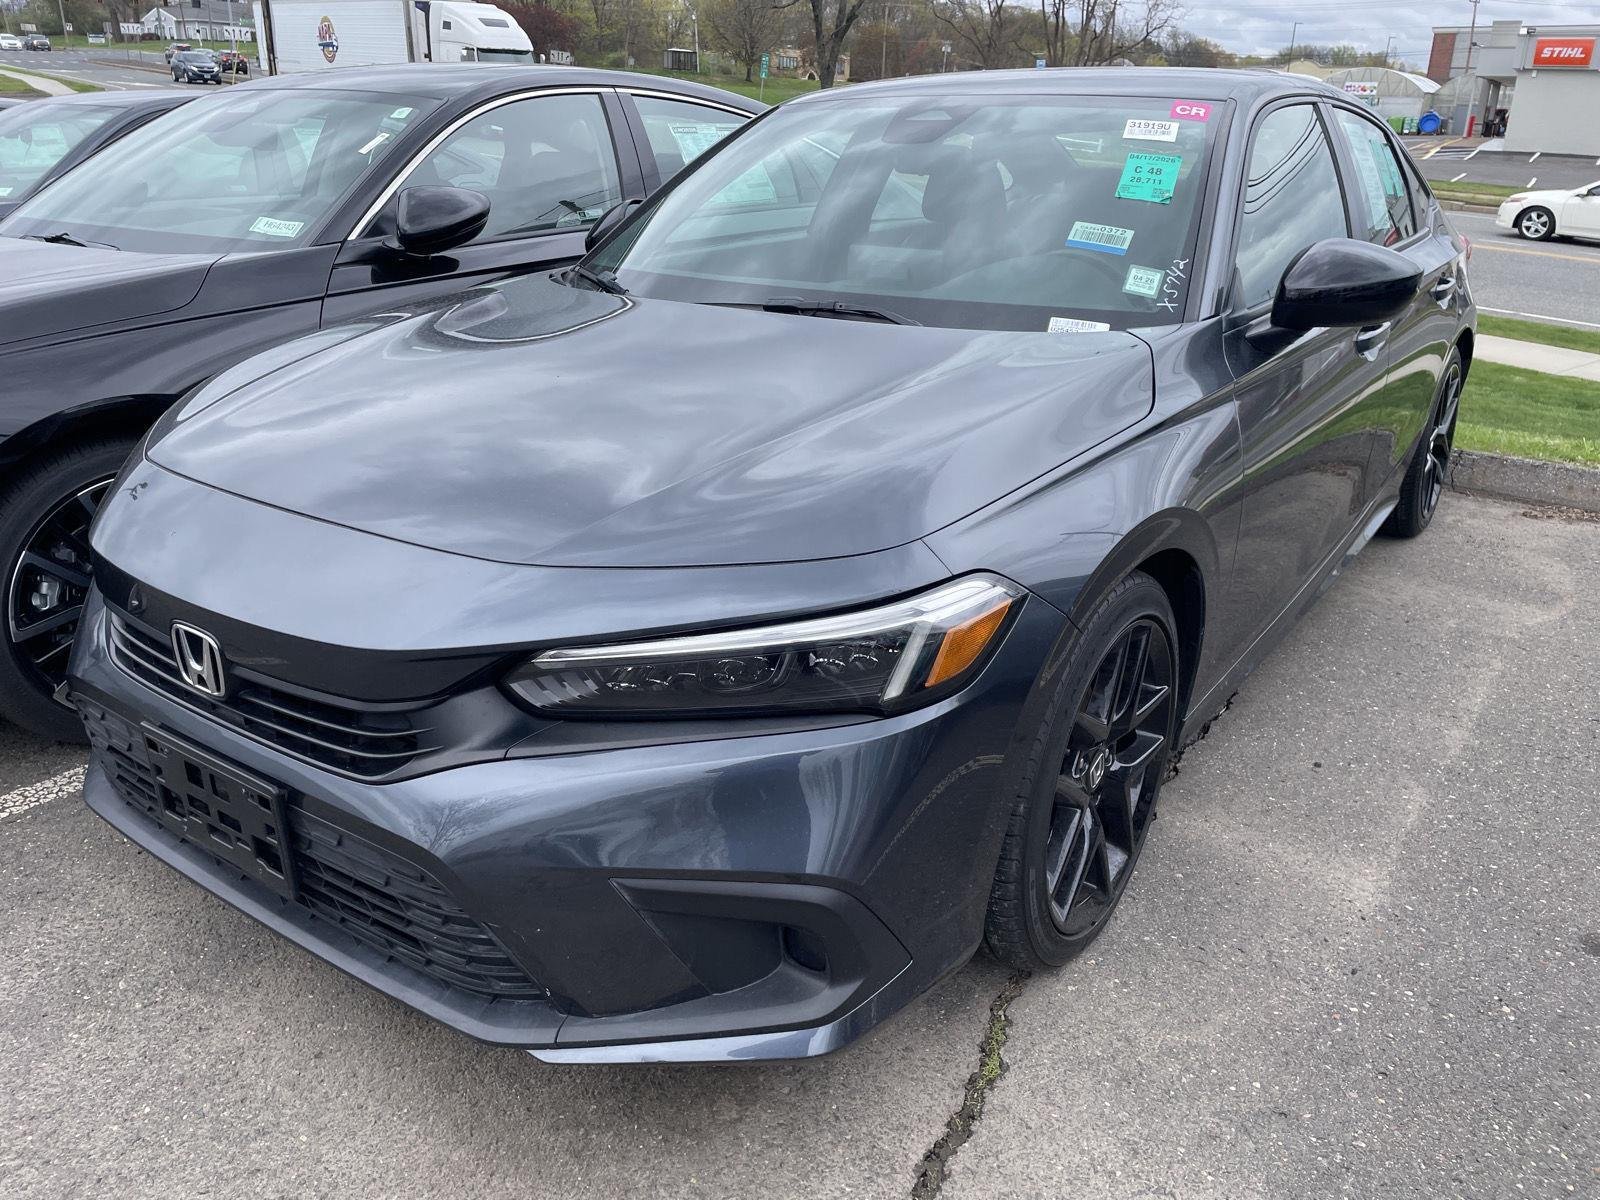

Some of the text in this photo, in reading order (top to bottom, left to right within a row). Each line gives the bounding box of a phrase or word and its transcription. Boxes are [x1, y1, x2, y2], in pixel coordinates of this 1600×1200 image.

[1541, 47, 1585, 58] STIHL
[1175, 105, 1206, 117] CR
[1129, 121, 1171, 131] 31919U
[1134, 165, 1163, 176] C 48
